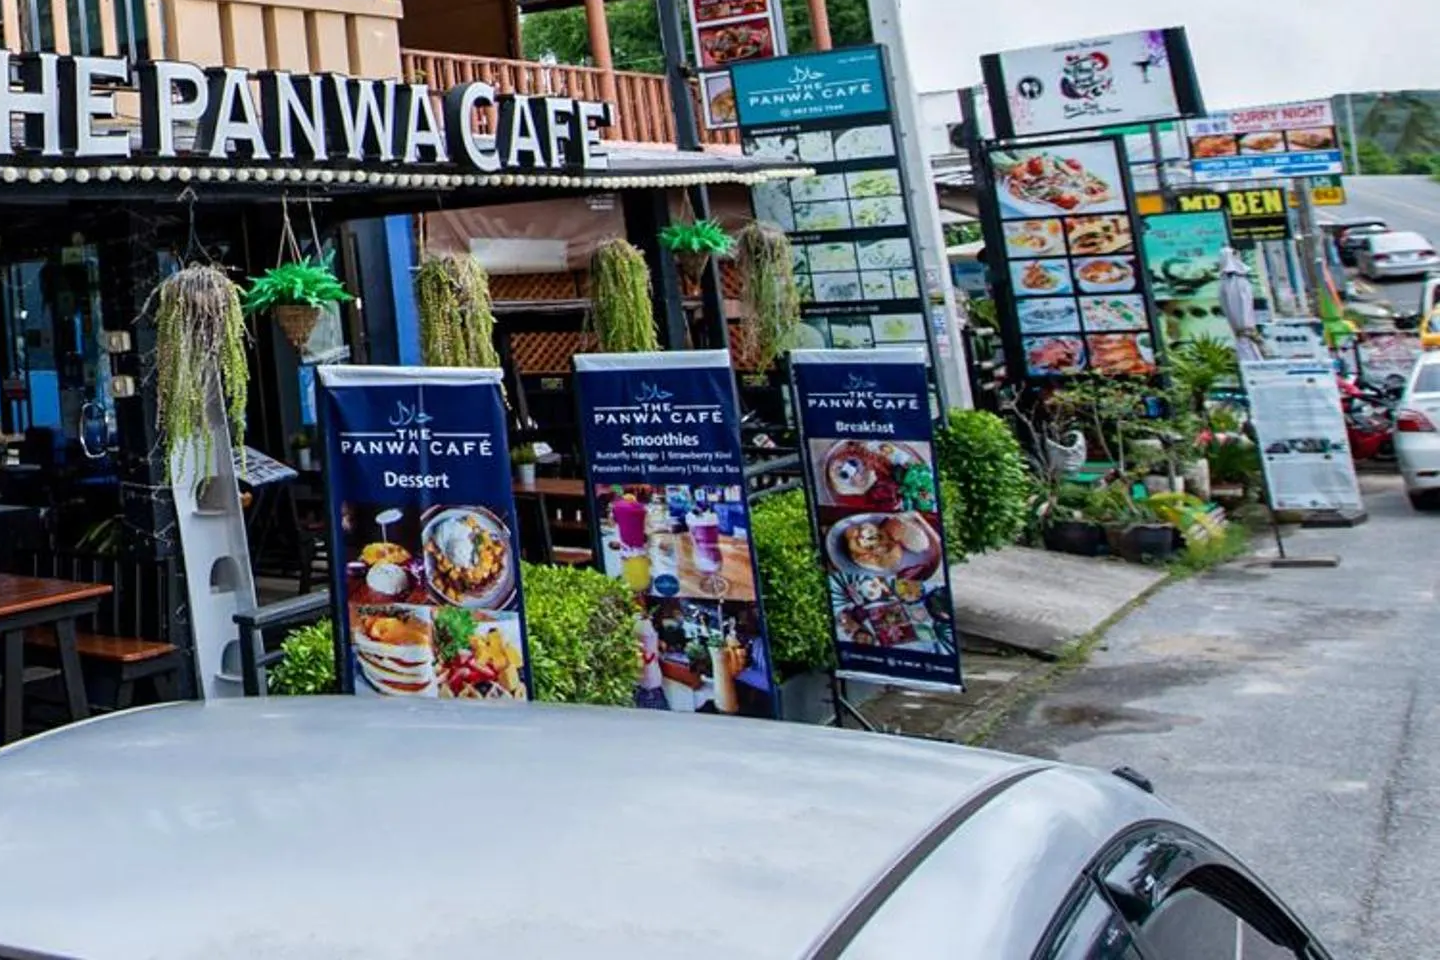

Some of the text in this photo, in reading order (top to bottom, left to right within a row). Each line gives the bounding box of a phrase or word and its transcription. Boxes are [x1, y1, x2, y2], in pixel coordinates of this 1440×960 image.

[795, 82, 822, 91] THE
[749, 92, 814, 107] PANWA
[154, 60, 449, 164] PANWA
[460, 81, 615, 173] CAFE
[1228, 189, 1284, 216] BEN
[849, 391, 875, 399] THE
[641, 403, 671, 412] THE
[808, 398, 867, 409] PANWA
[389, 400, 433, 426] حلال
[594, 412, 663, 425] PANWA
[396, 428, 431, 440] THE
[836, 420, 896, 434] Breakfast
[622, 433, 699, 447] Smoothies
[341, 439, 492, 456] PANWA CAFÉ
[668, 451, 712, 461] Strawberry
[384, 471, 450, 489] Dessert
